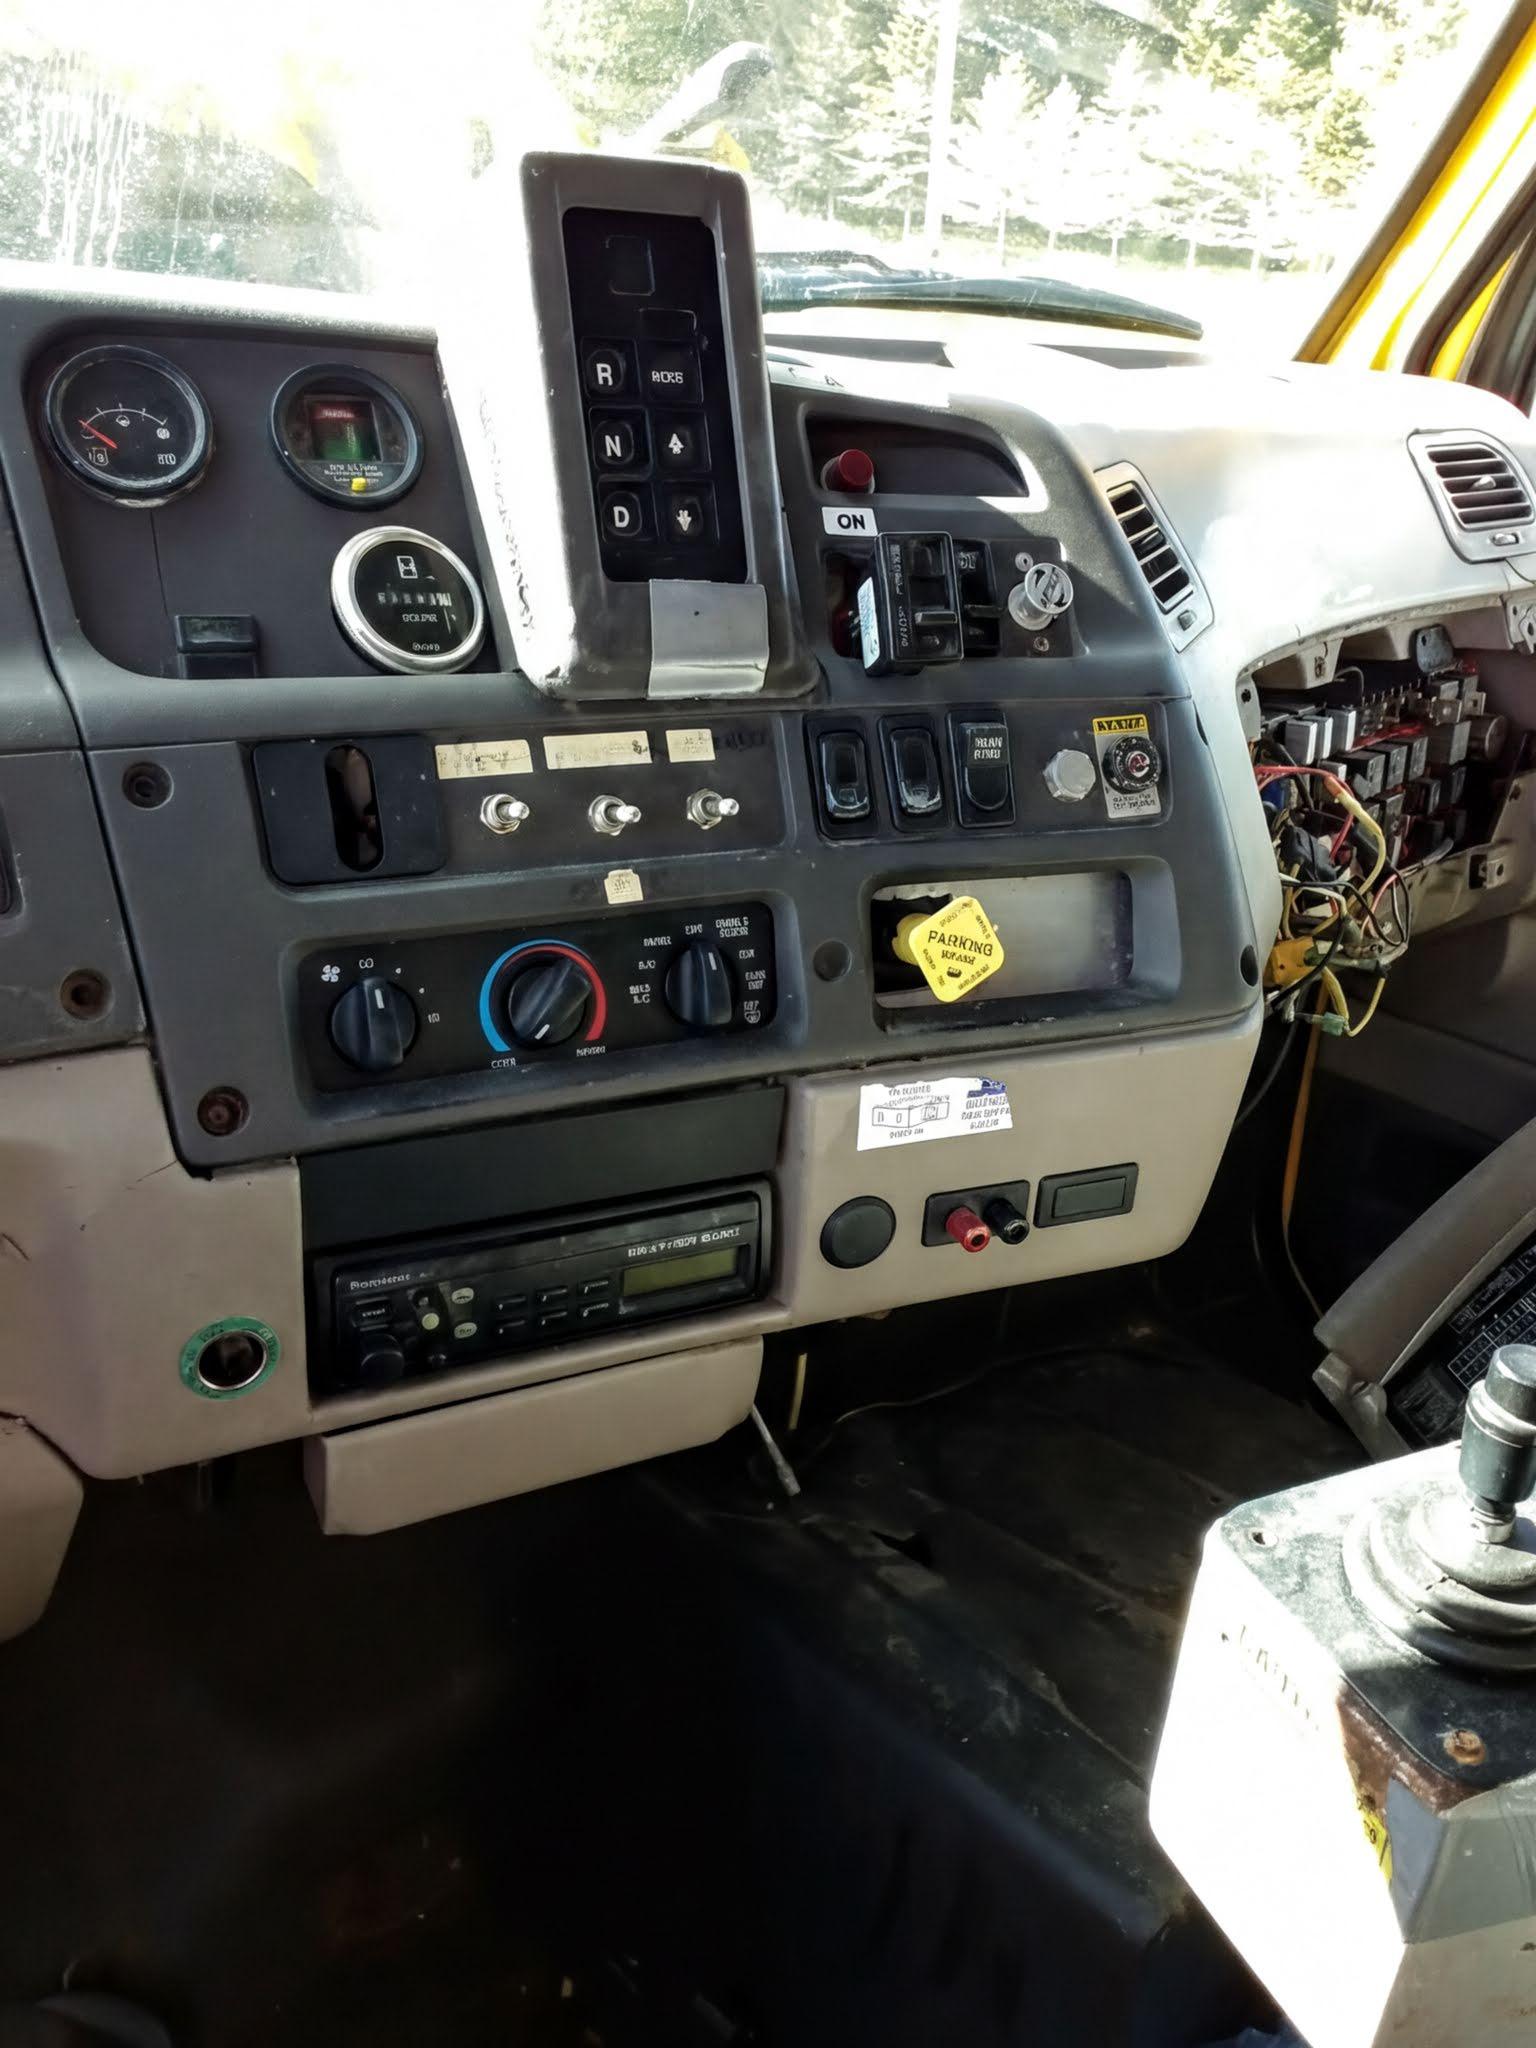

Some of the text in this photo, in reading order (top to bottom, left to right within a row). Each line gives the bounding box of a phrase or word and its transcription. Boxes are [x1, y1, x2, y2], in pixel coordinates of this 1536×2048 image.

[596, 363, 613, 386] R
[605, 435, 622, 457] N
[613, 506, 630, 528] D
[837, 513, 866, 530] ON
